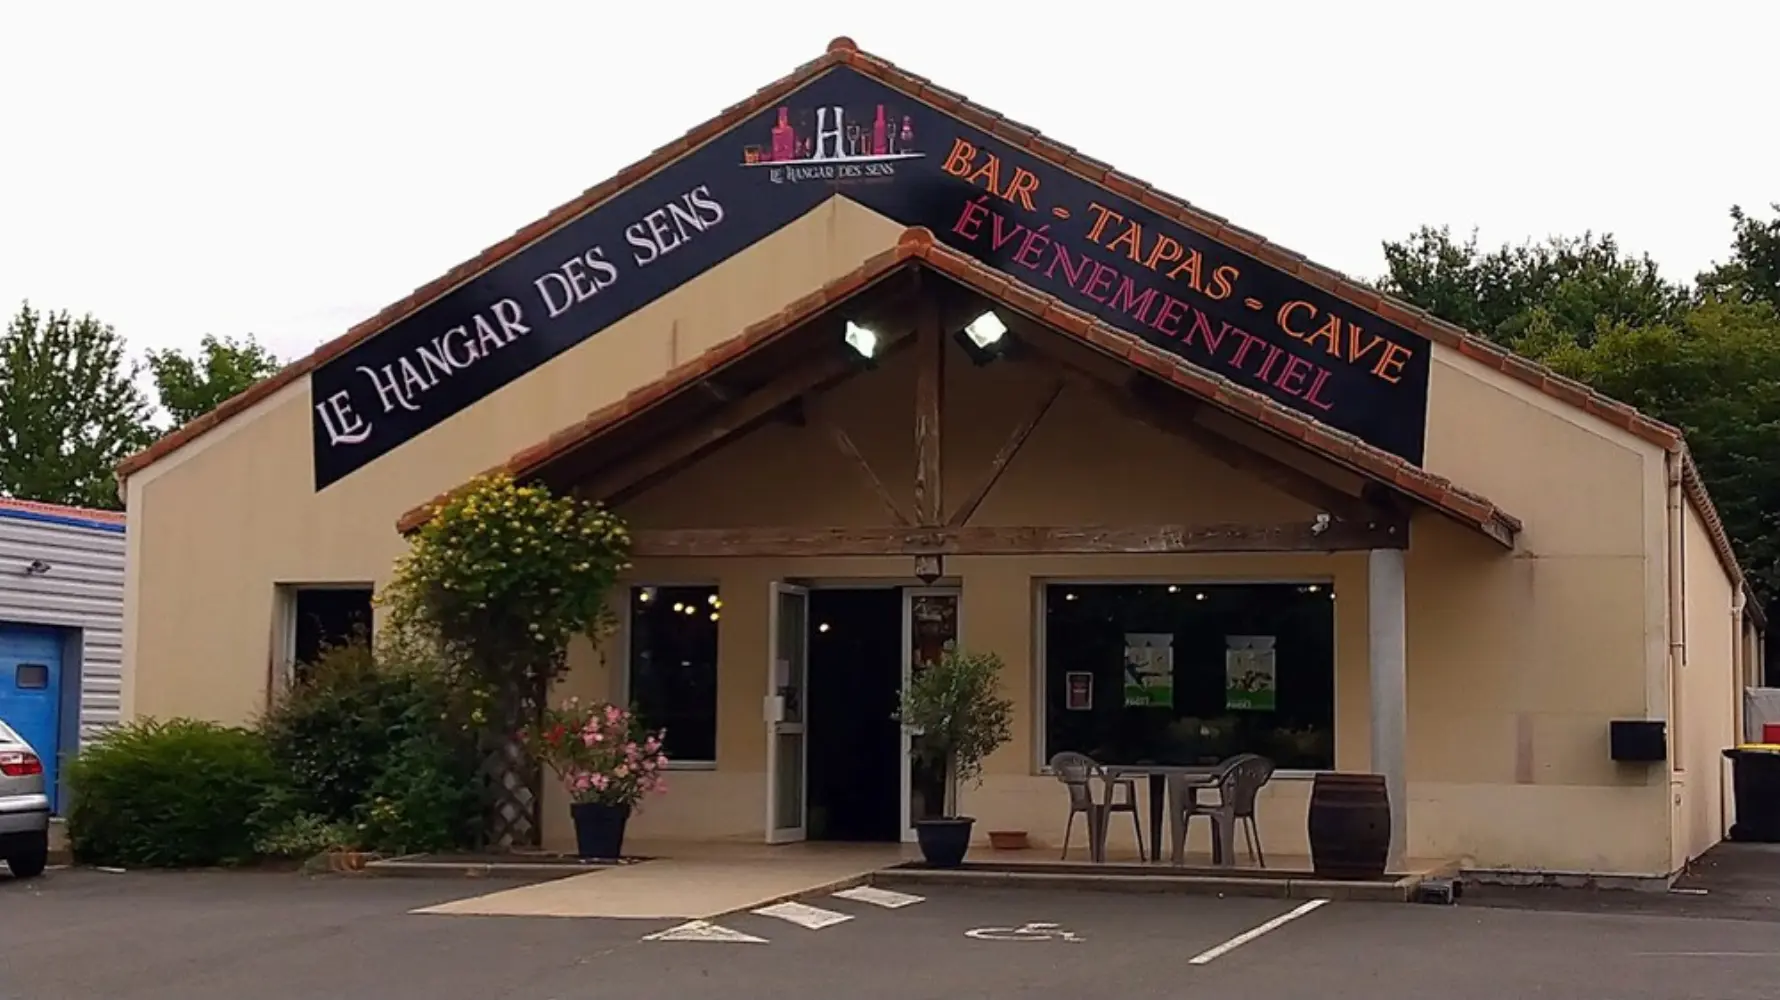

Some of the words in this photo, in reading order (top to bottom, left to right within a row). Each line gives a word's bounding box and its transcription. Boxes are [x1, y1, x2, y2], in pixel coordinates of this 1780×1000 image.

[840, 164, 861, 178] DES
[866, 163, 894, 176] SENS
[941, 137, 1042, 212] BAR
[1087, 203, 1240, 300] TAPAS
[1277, 300, 1413, 385] CAVE
[317, 391, 373, 446] LE
[357, 299, 531, 411] HANGAR
[533, 246, 618, 319] DES
[625, 185, 725, 267] SENS
[952, 195, 1334, 411] ÉVÉNEMENTIEL
